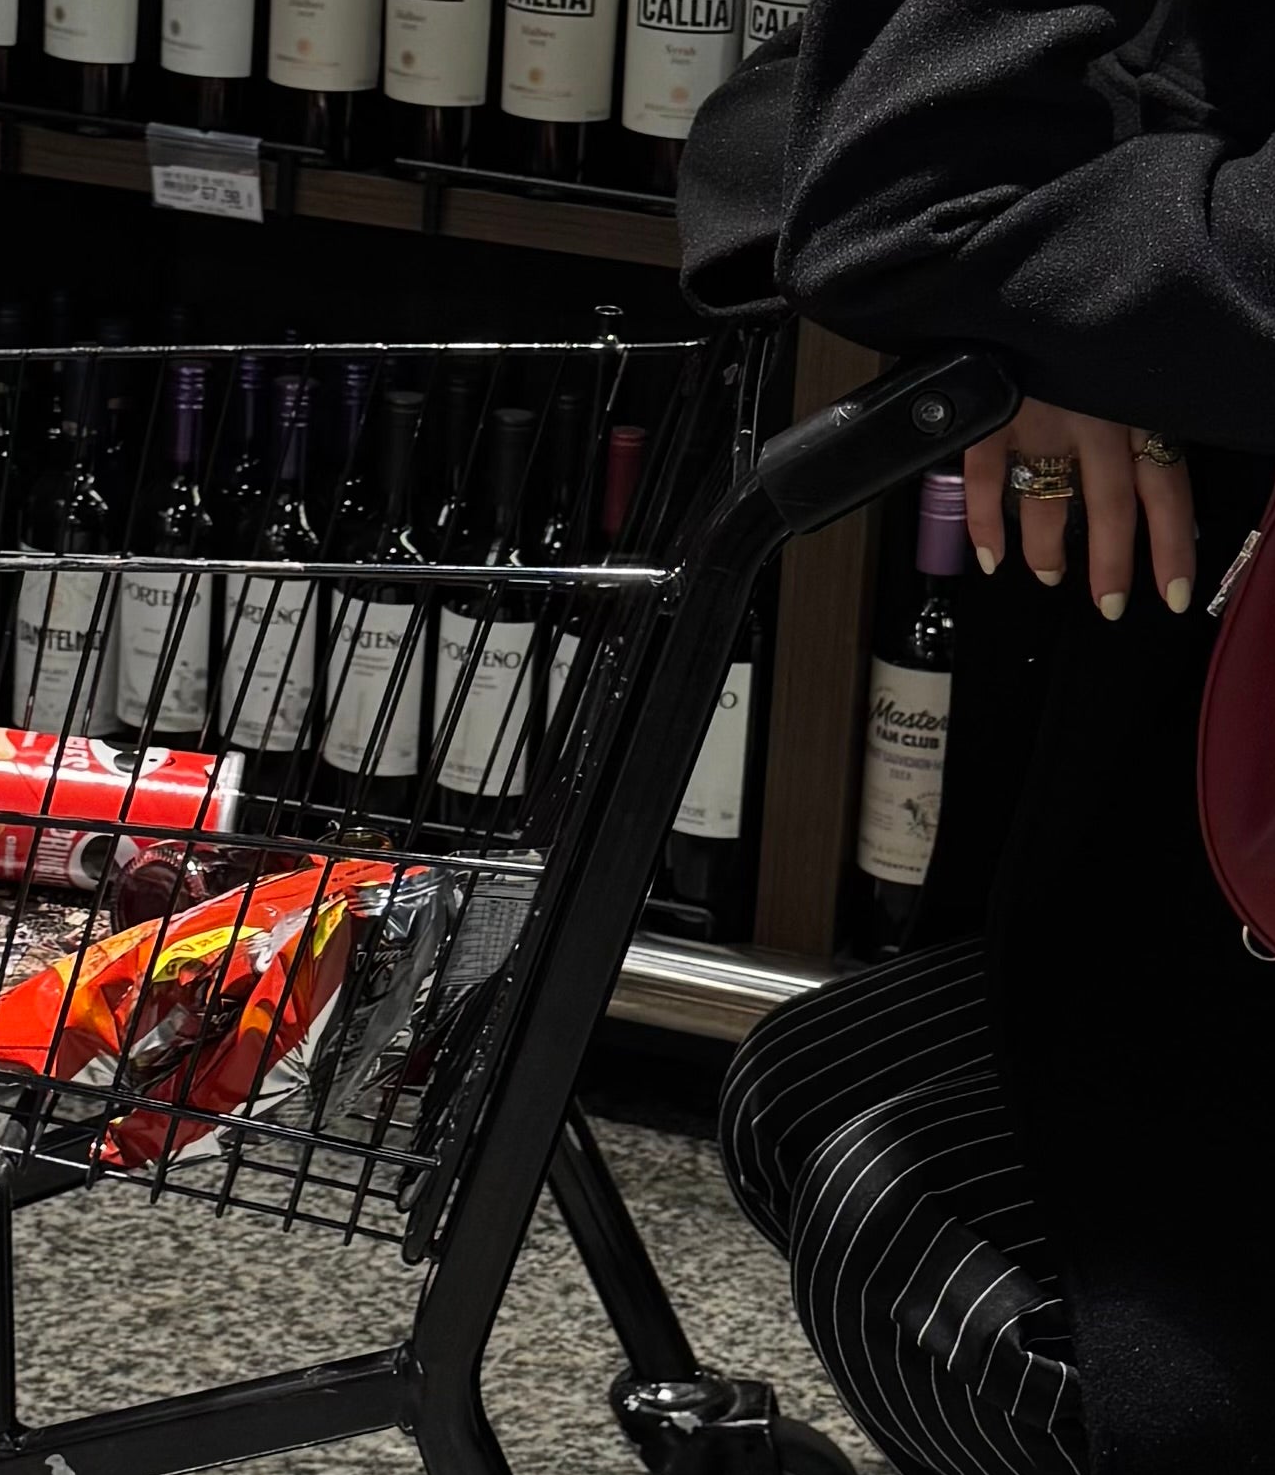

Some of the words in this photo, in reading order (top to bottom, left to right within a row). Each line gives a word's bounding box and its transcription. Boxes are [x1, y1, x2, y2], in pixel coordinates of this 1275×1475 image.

[751, 4, 804, 37] CAL
[125, 580, 201, 608] PORTEO
[901, 732, 940, 750] CLUB
